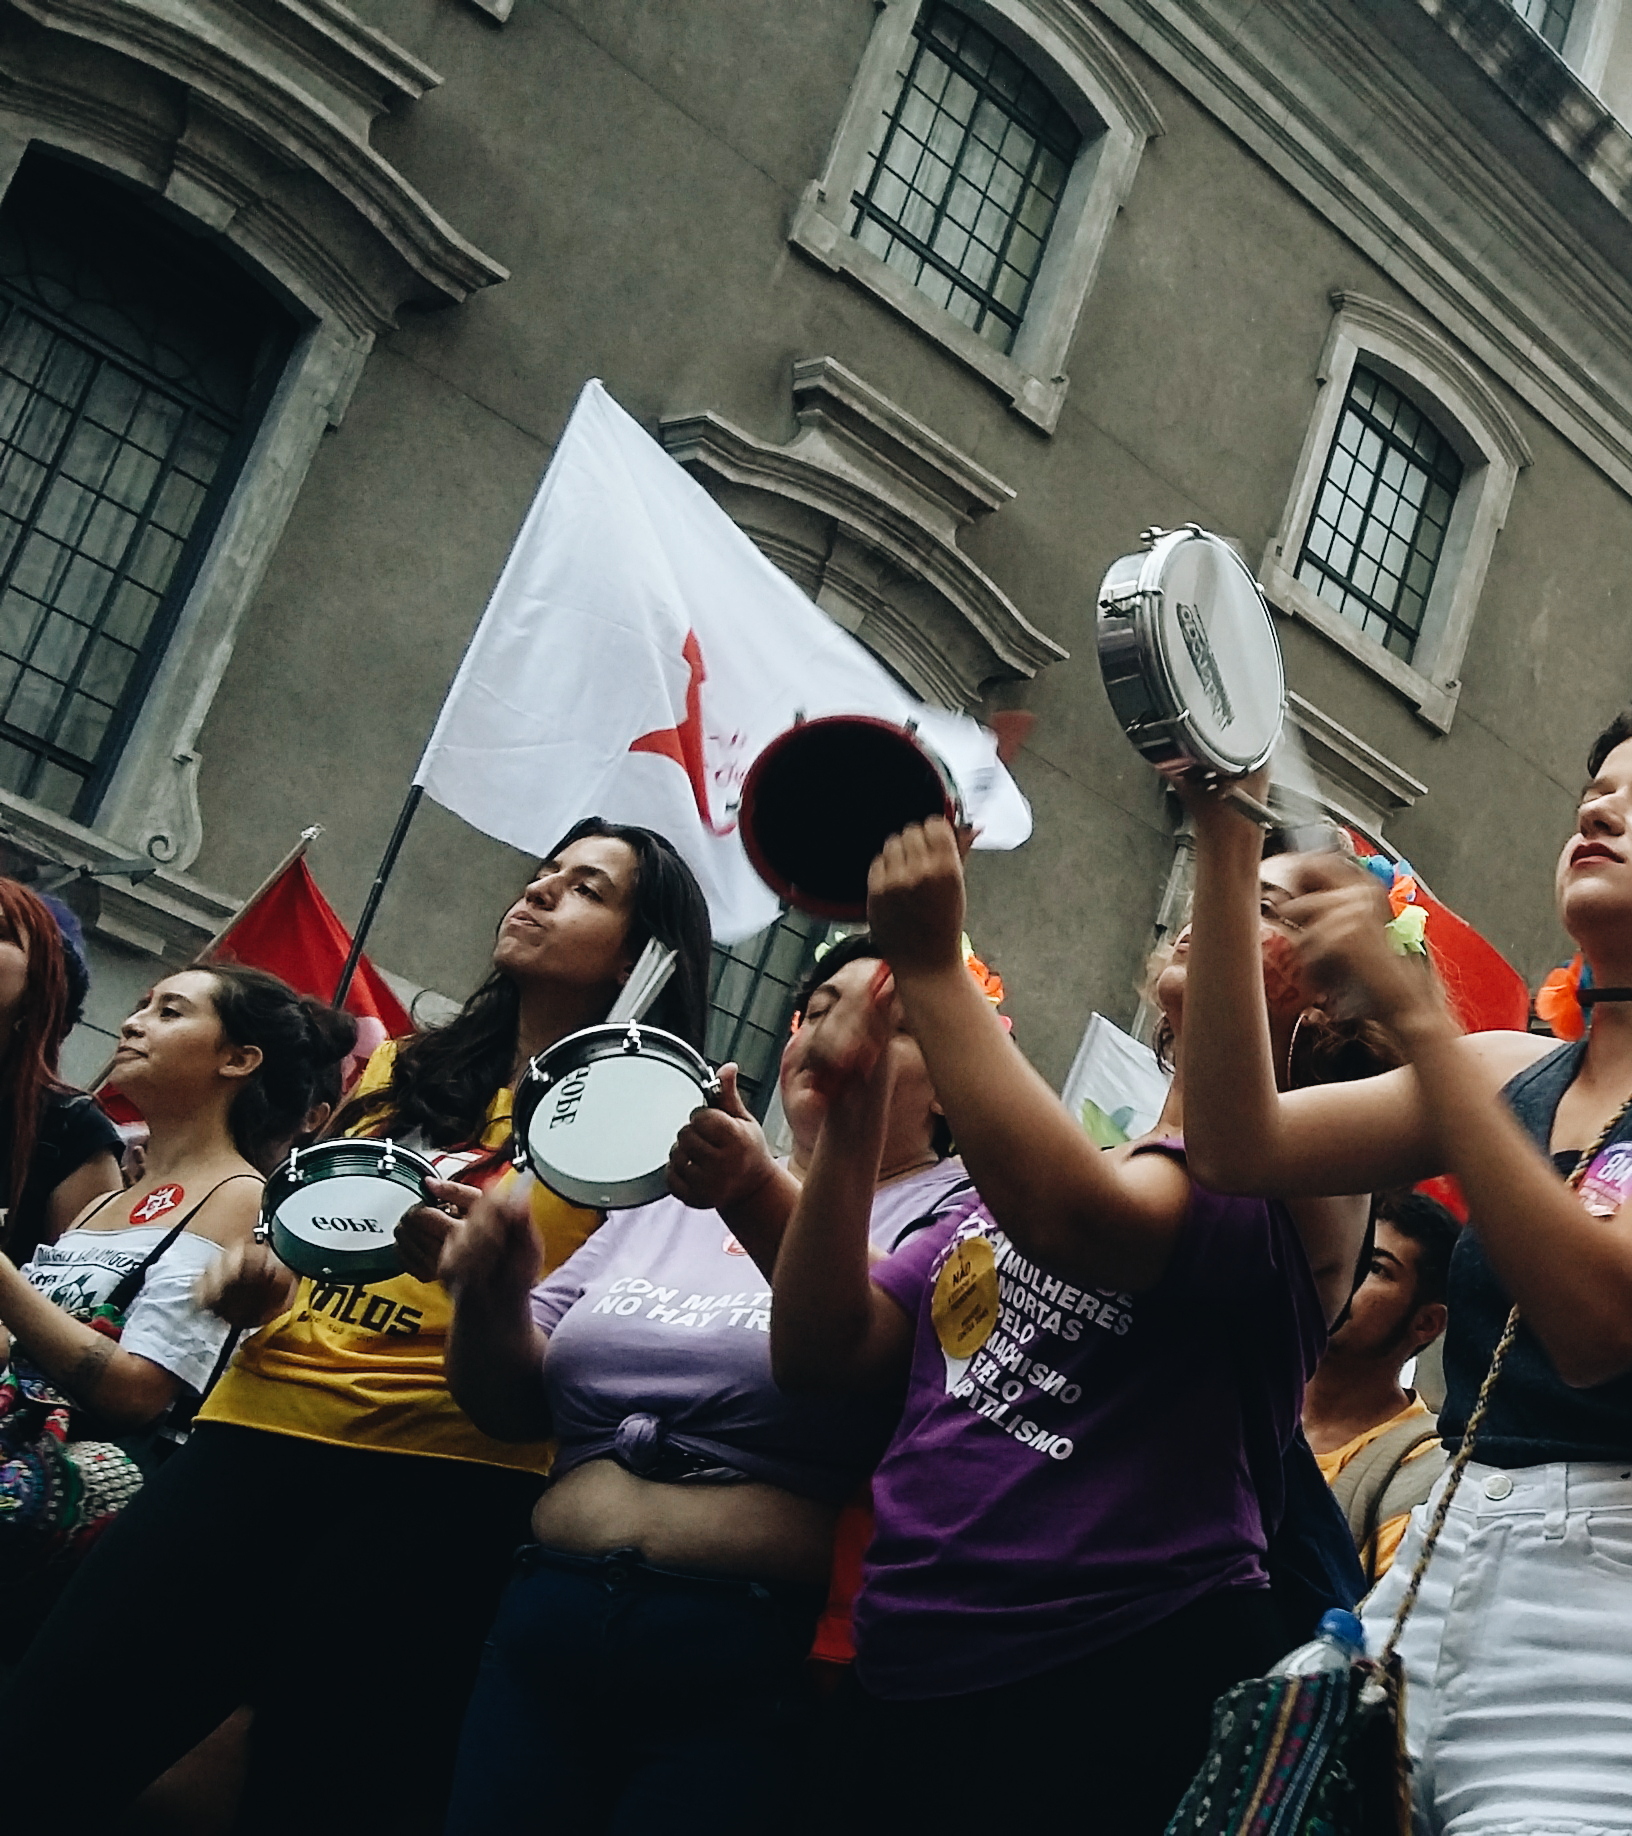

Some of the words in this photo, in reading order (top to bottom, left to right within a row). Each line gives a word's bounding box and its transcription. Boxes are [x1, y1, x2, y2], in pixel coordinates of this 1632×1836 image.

[591, 1295, 642, 1316] NO
[645, 1304, 723, 1328] HAY
[609, 1277, 680, 1304] CON
[679, 1291, 773, 1311] MALT
[1000, 1275, 1084, 1342] MORTAS
[1001, 1253, 1133, 1336] MULHERES
[985, 1331, 1082, 1404] MACHISMO
